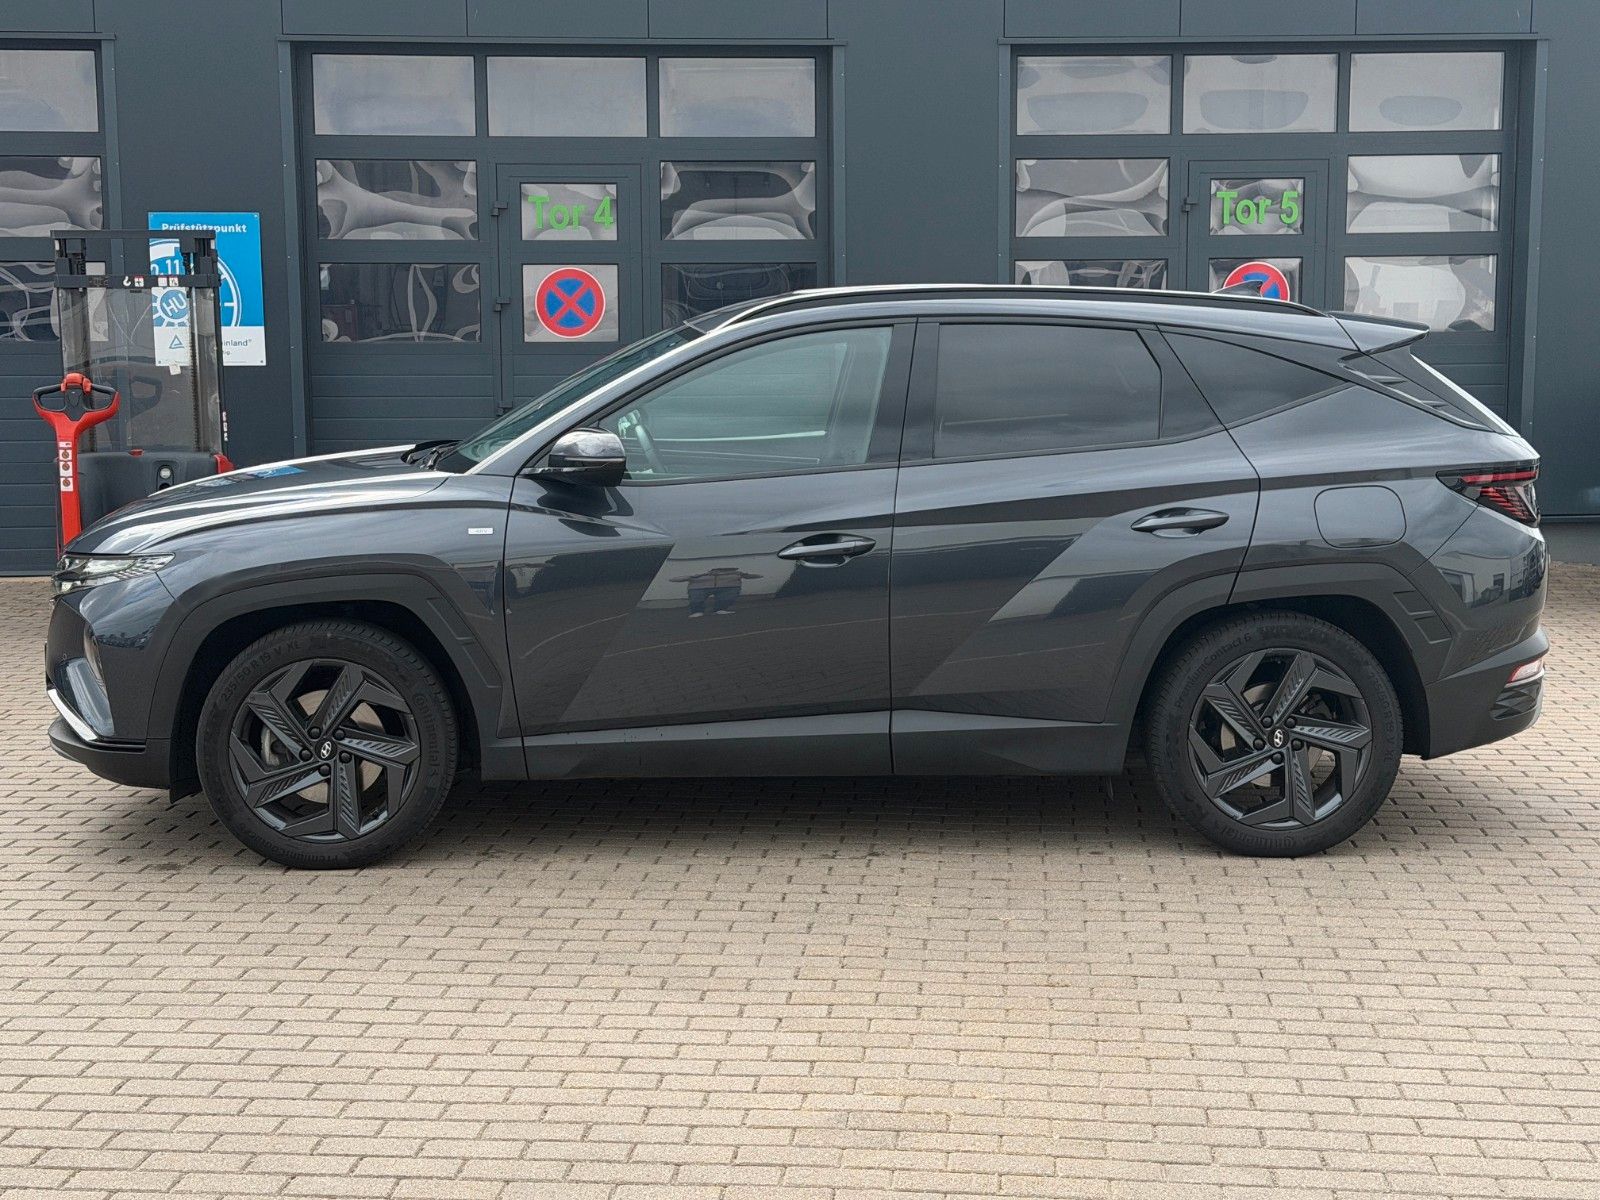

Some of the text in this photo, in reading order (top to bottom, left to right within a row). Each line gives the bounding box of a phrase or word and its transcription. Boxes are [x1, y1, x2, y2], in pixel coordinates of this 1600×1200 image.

[527, 195, 614, 230] Tor 4
[1216, 190, 1299, 225] Tor 5
[162, 293, 187, 317] HU
